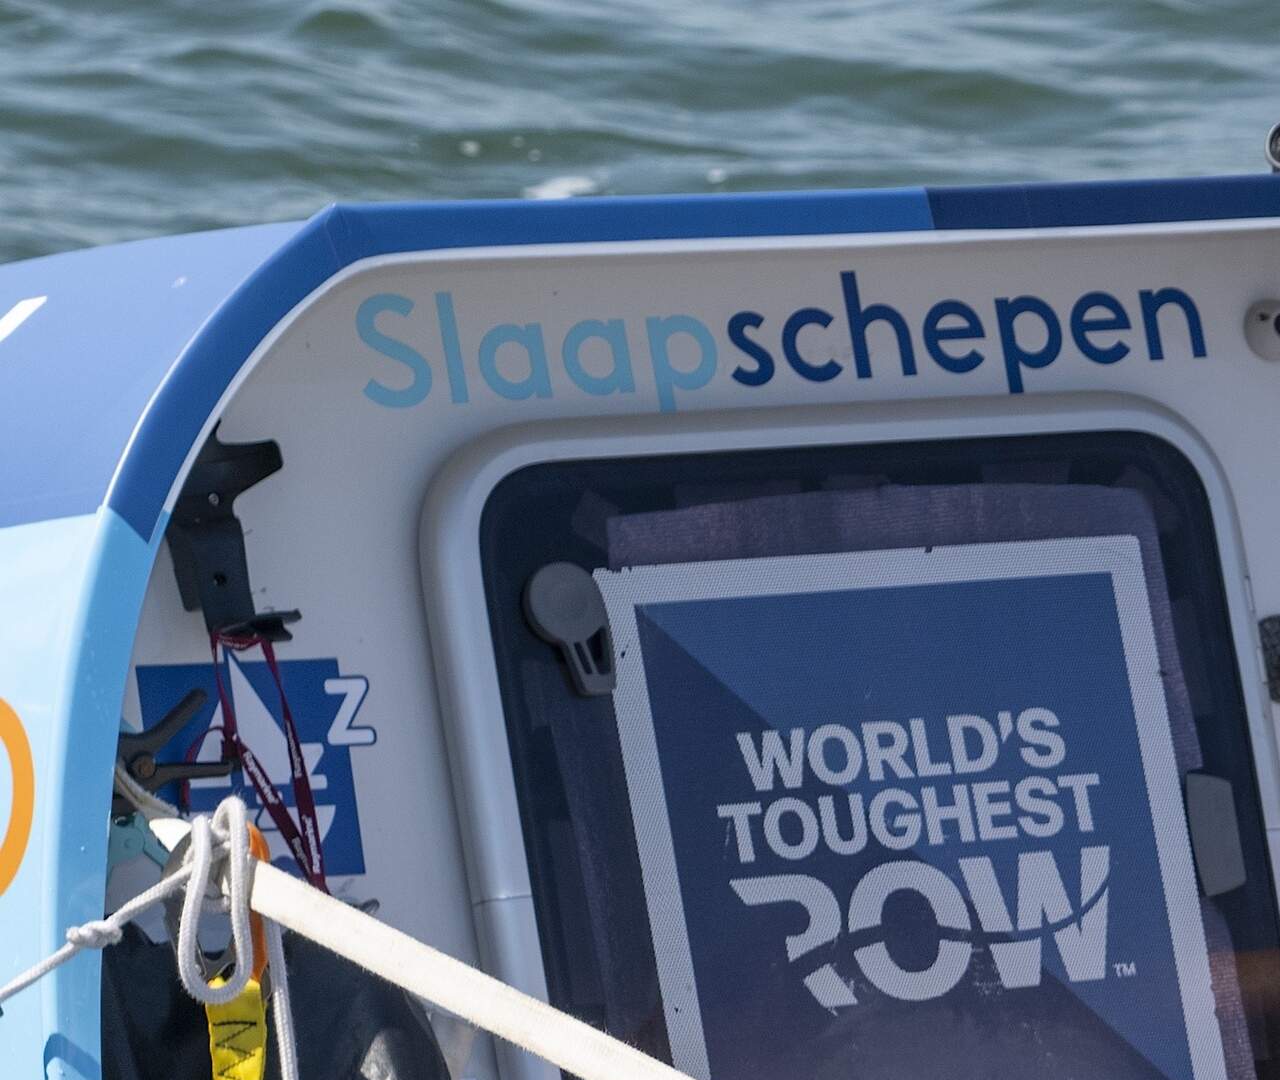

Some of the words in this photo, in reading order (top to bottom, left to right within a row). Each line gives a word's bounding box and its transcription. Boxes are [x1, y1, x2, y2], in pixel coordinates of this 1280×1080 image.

[355, 271, 1206, 411] Slaapschepen
[737, 707, 1066, 792] WORLD'S
[717, 773, 1100, 862] TOUGHEST
[729, 846, 1110, 1009] ROW
